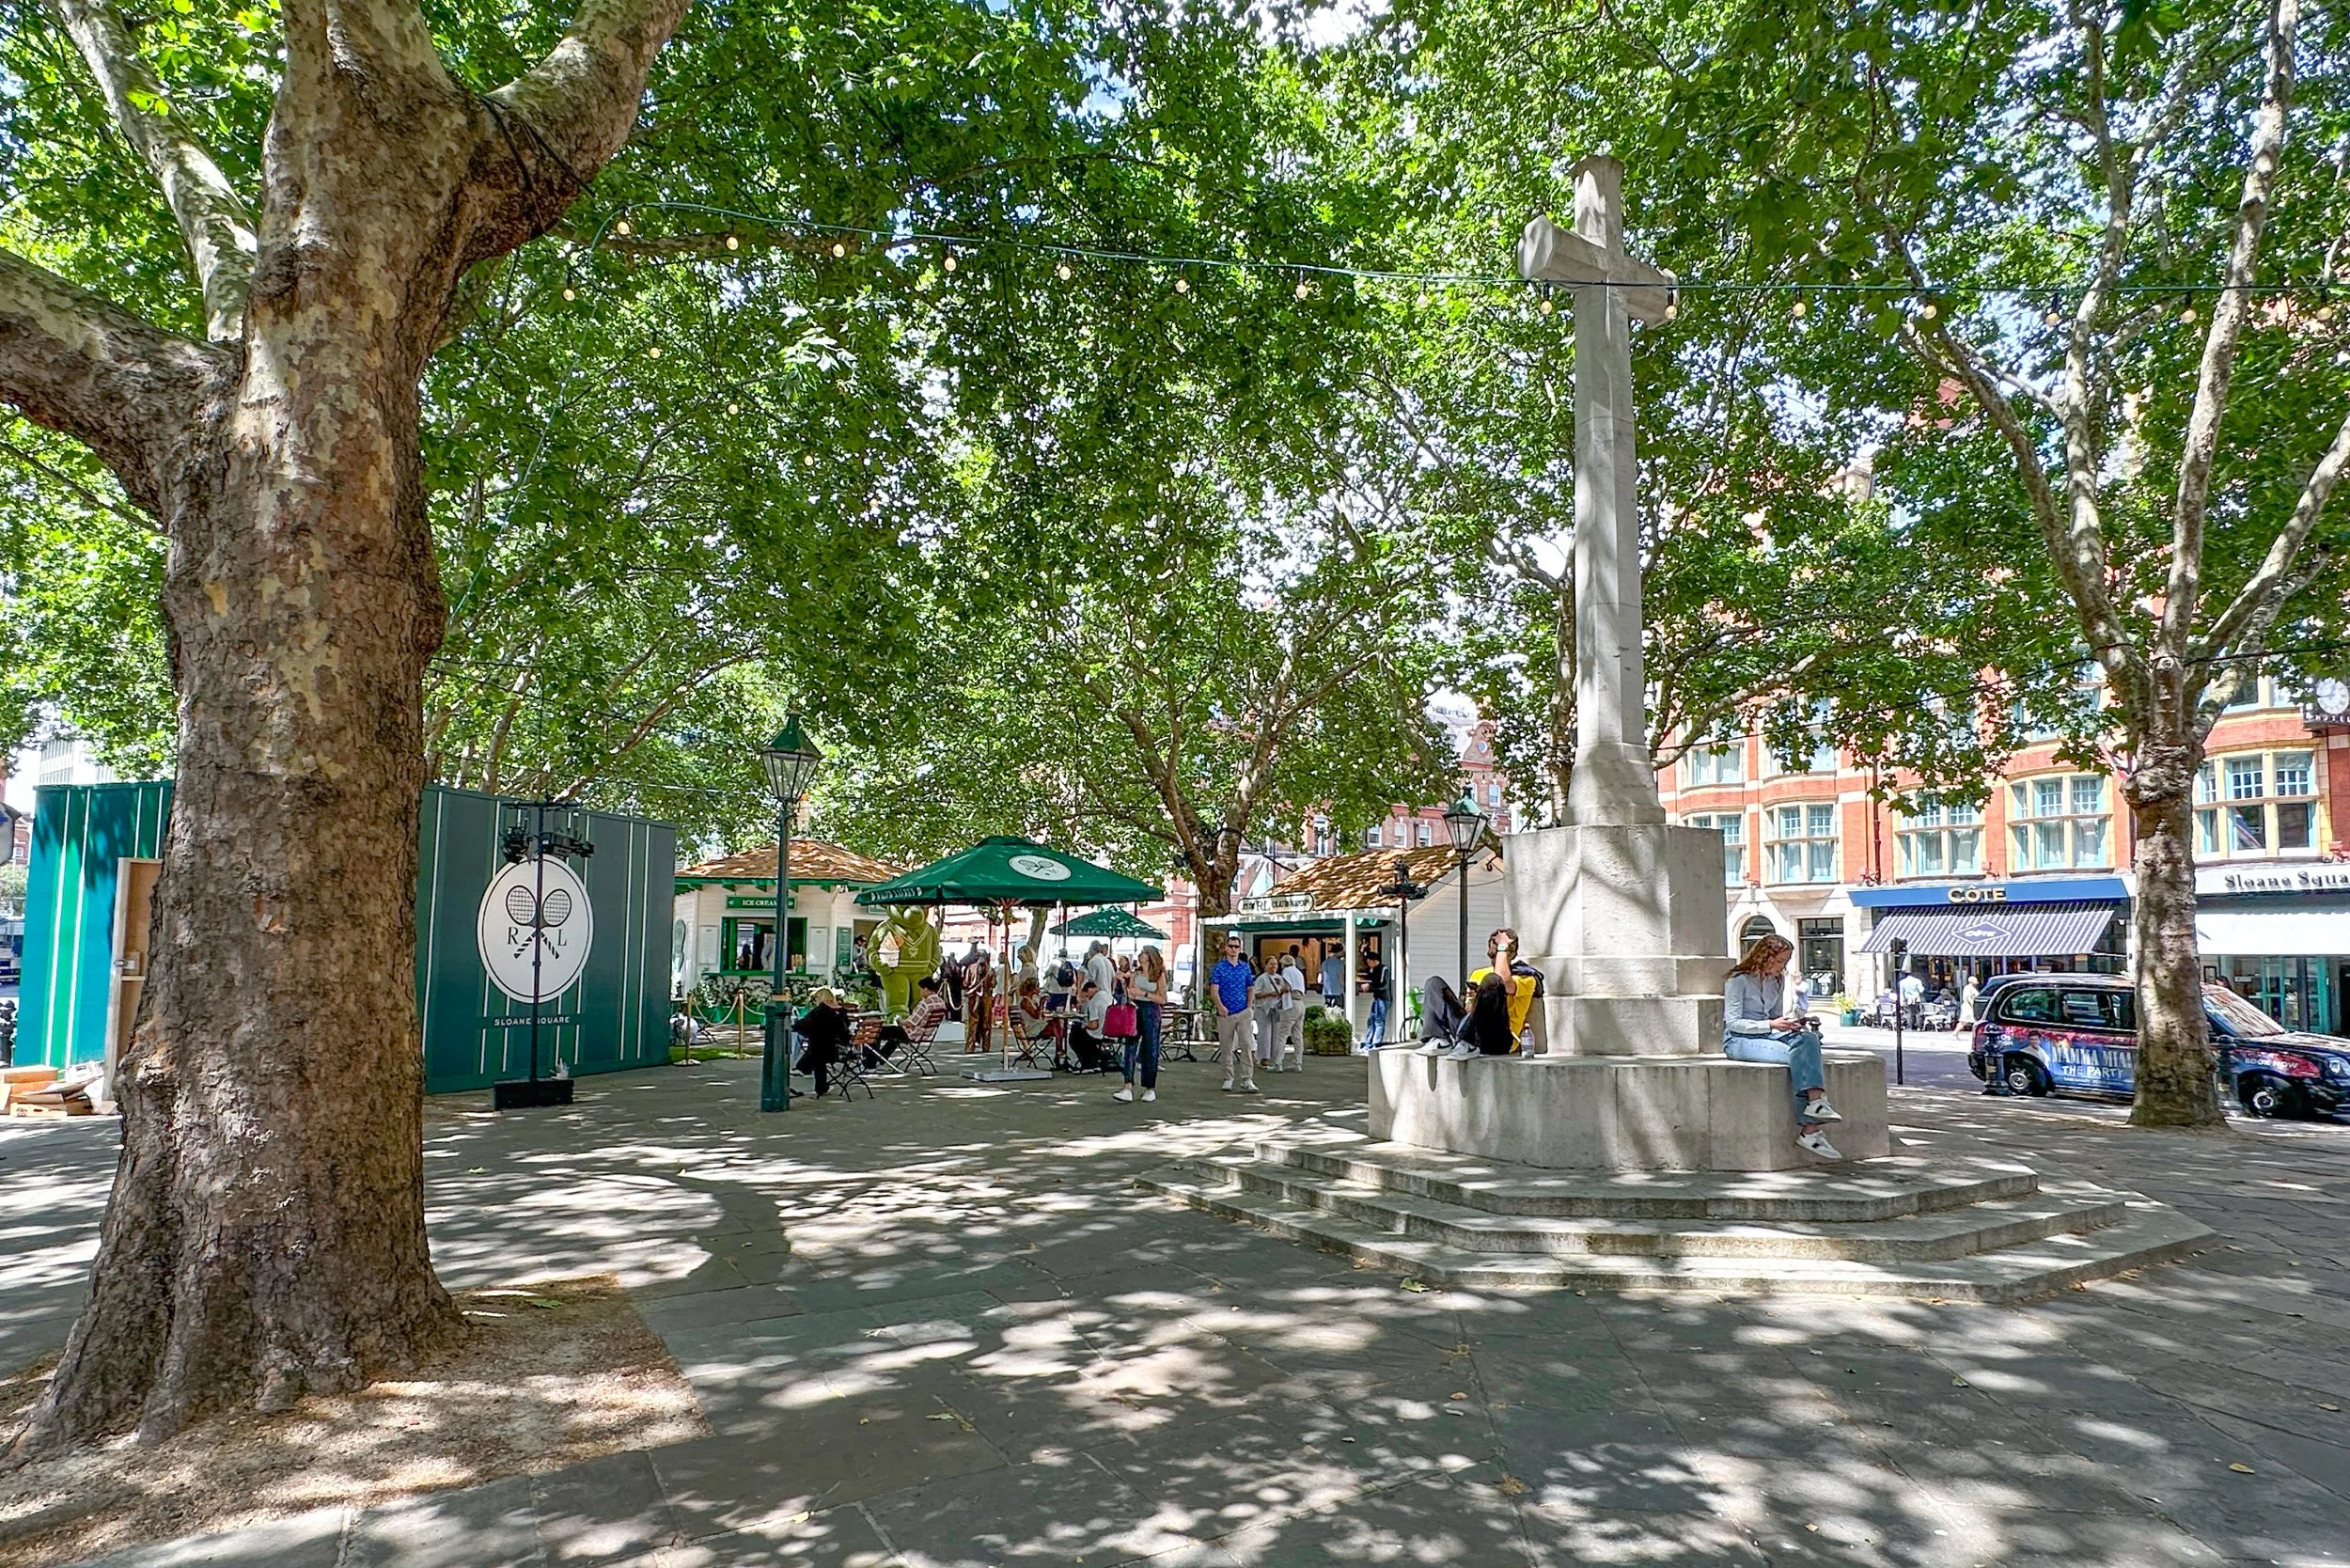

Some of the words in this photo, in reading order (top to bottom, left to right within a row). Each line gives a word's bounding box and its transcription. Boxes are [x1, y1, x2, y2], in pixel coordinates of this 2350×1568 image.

[2224, 874, 2292, 889] Sloane
[1947, 885, 2008, 903] CÔTE
[507, 926, 519, 946] R
[556, 928, 568, 947] L
[494, 1017, 532, 1027] SLOANE
[2051, 1045, 2099, 1067] MAMMA
[2244, 1058, 2271, 1067] BOOK
[2272, 1059, 2299, 1070] NOW
[2061, 1065, 2084, 1077] THE
[2087, 1066, 2124, 1080] PARTY
